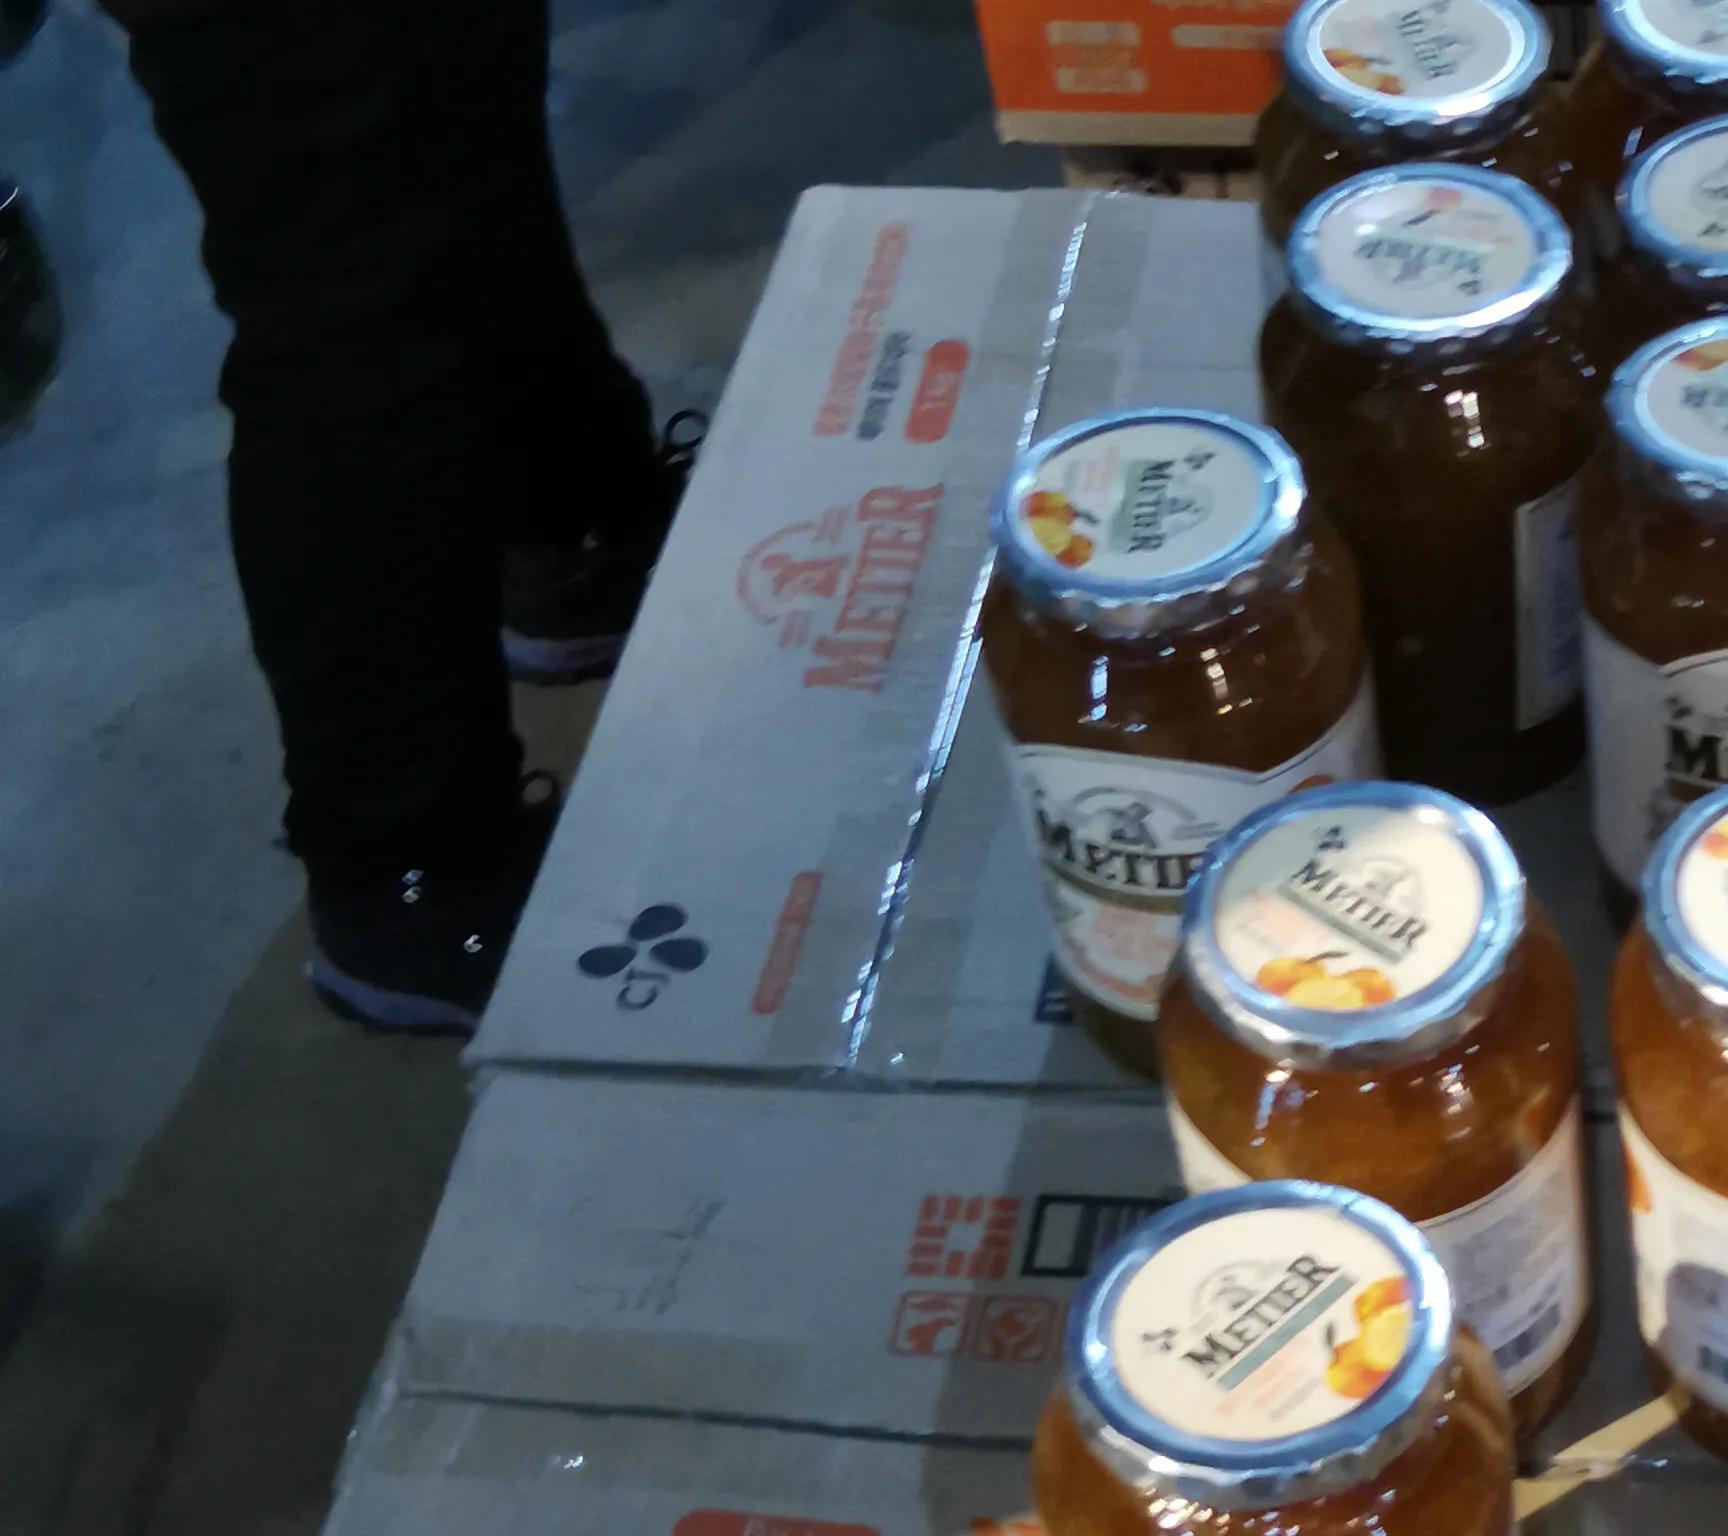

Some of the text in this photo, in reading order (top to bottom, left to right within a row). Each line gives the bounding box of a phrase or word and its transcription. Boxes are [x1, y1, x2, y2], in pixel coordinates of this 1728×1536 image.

[806, 480, 944, 693] METIER
[618, 967, 671, 1011] CJ
[1181, 1252, 1343, 1378] METIER
